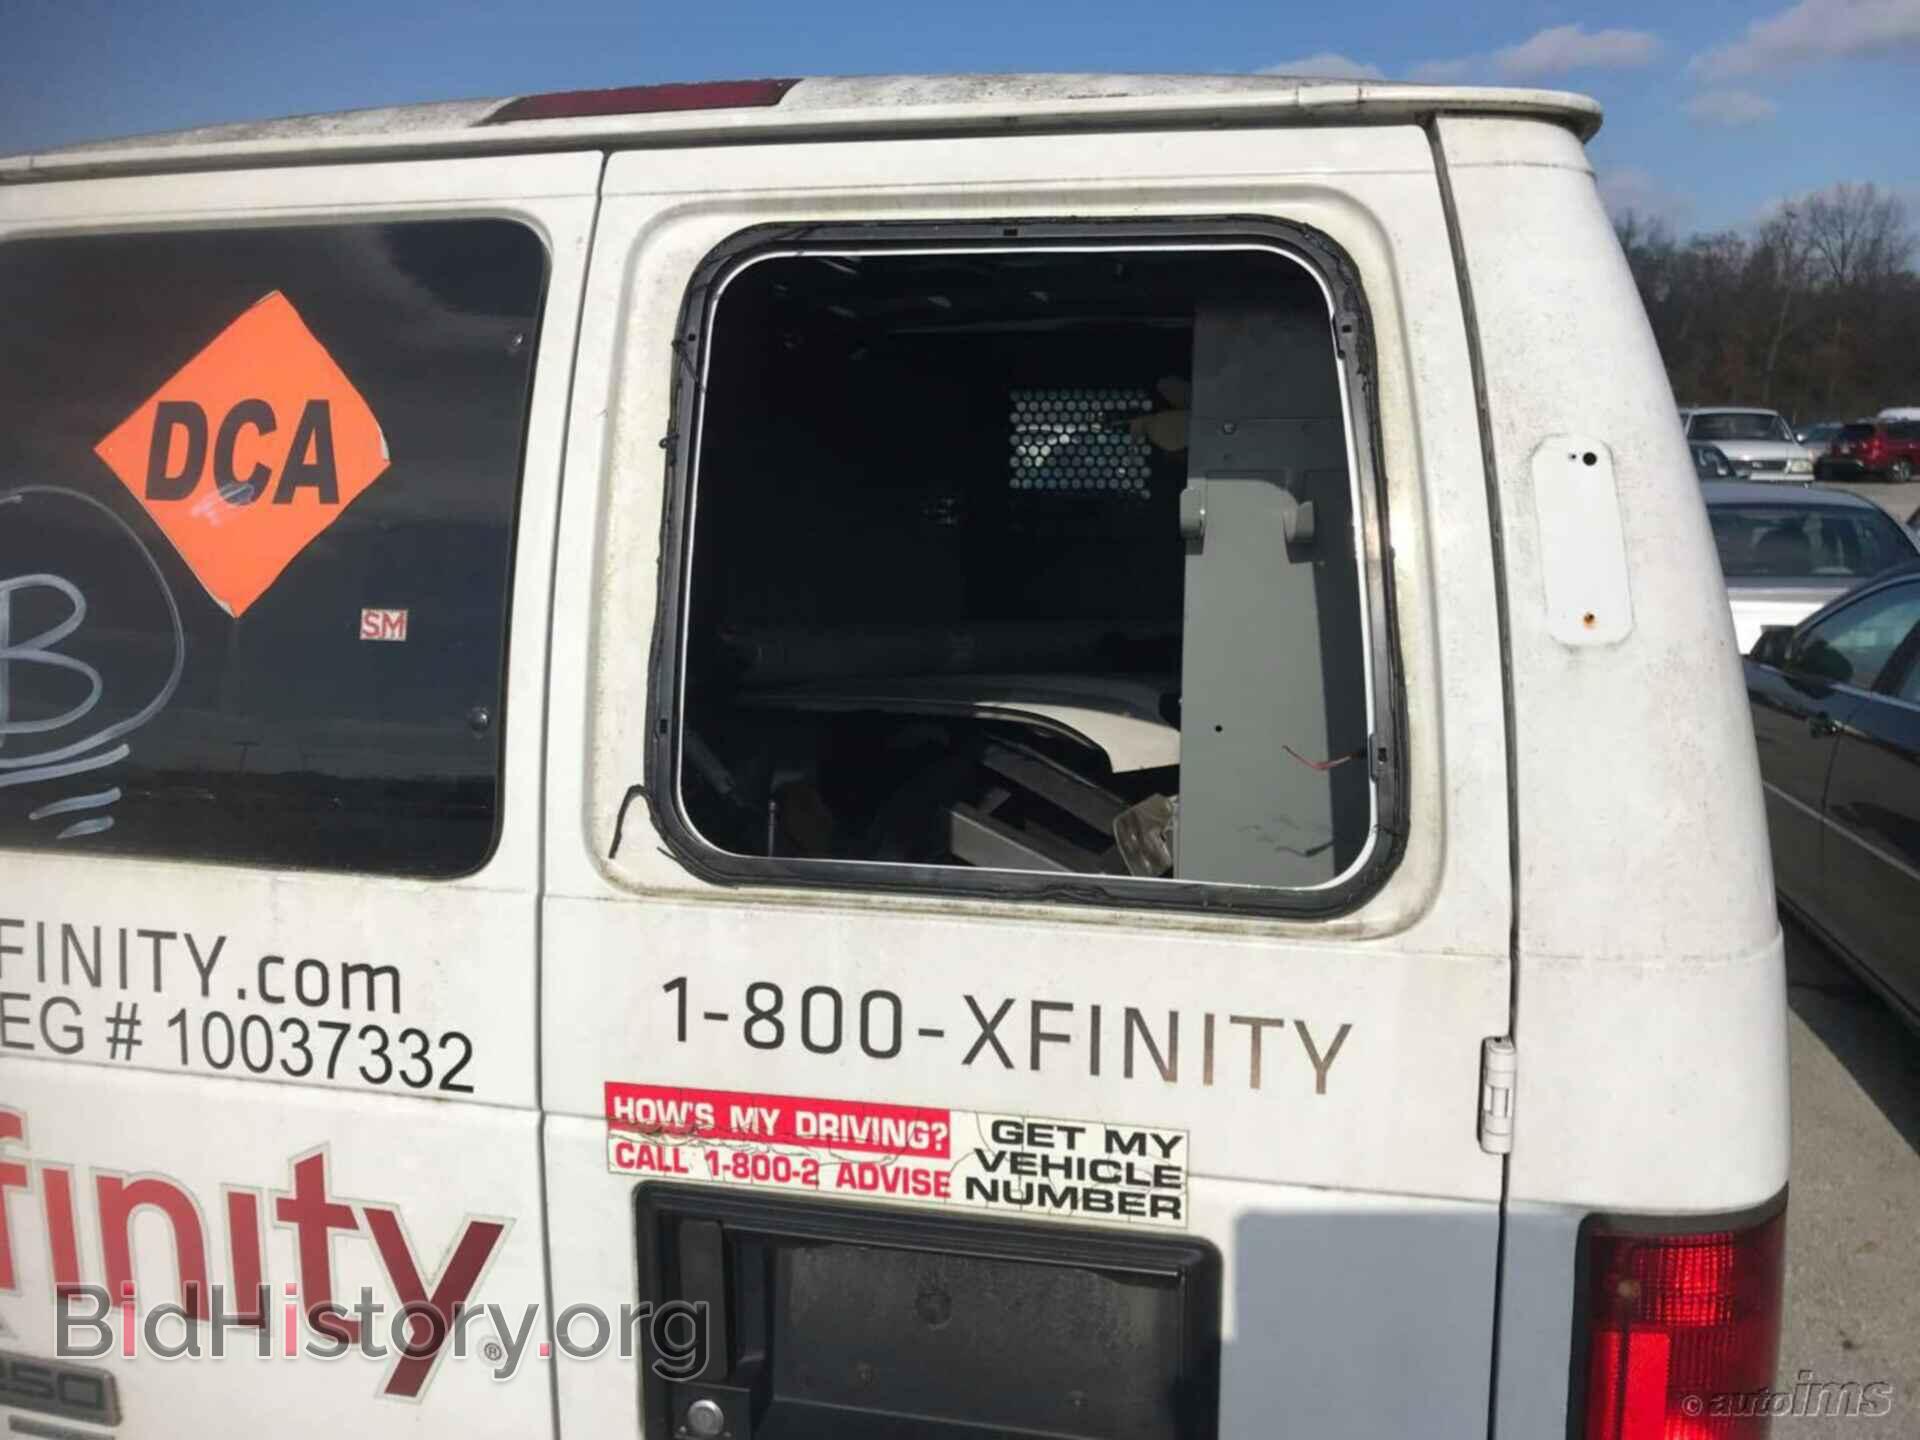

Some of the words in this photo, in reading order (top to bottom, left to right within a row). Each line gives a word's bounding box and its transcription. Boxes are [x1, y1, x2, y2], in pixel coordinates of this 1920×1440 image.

[145, 398, 340, 506] DCA
[363, 609, 405, 639] SM
[105, 1001, 143, 1061] #
[168, 1008, 474, 1094] 10037332
[661, 975, 1354, 1096] 1-800-XFINITY
[613, 1095, 714, 1130] HOW'S
[729, 1103, 780, 1137] MY
[795, 1110, 947, 1152] DRIVING?
[991, 1119, 1086, 1150] GET
[1104, 1129, 1184, 1159] MY
[615, 1142, 688, 1174] CALL
[703, 1150, 820, 1187] 1-800-2
[836, 1162, 952, 1199] ADVISE
[974, 1147, 1182, 1190] VEHICLE
[965, 1176, 1182, 1220] NUMBER
